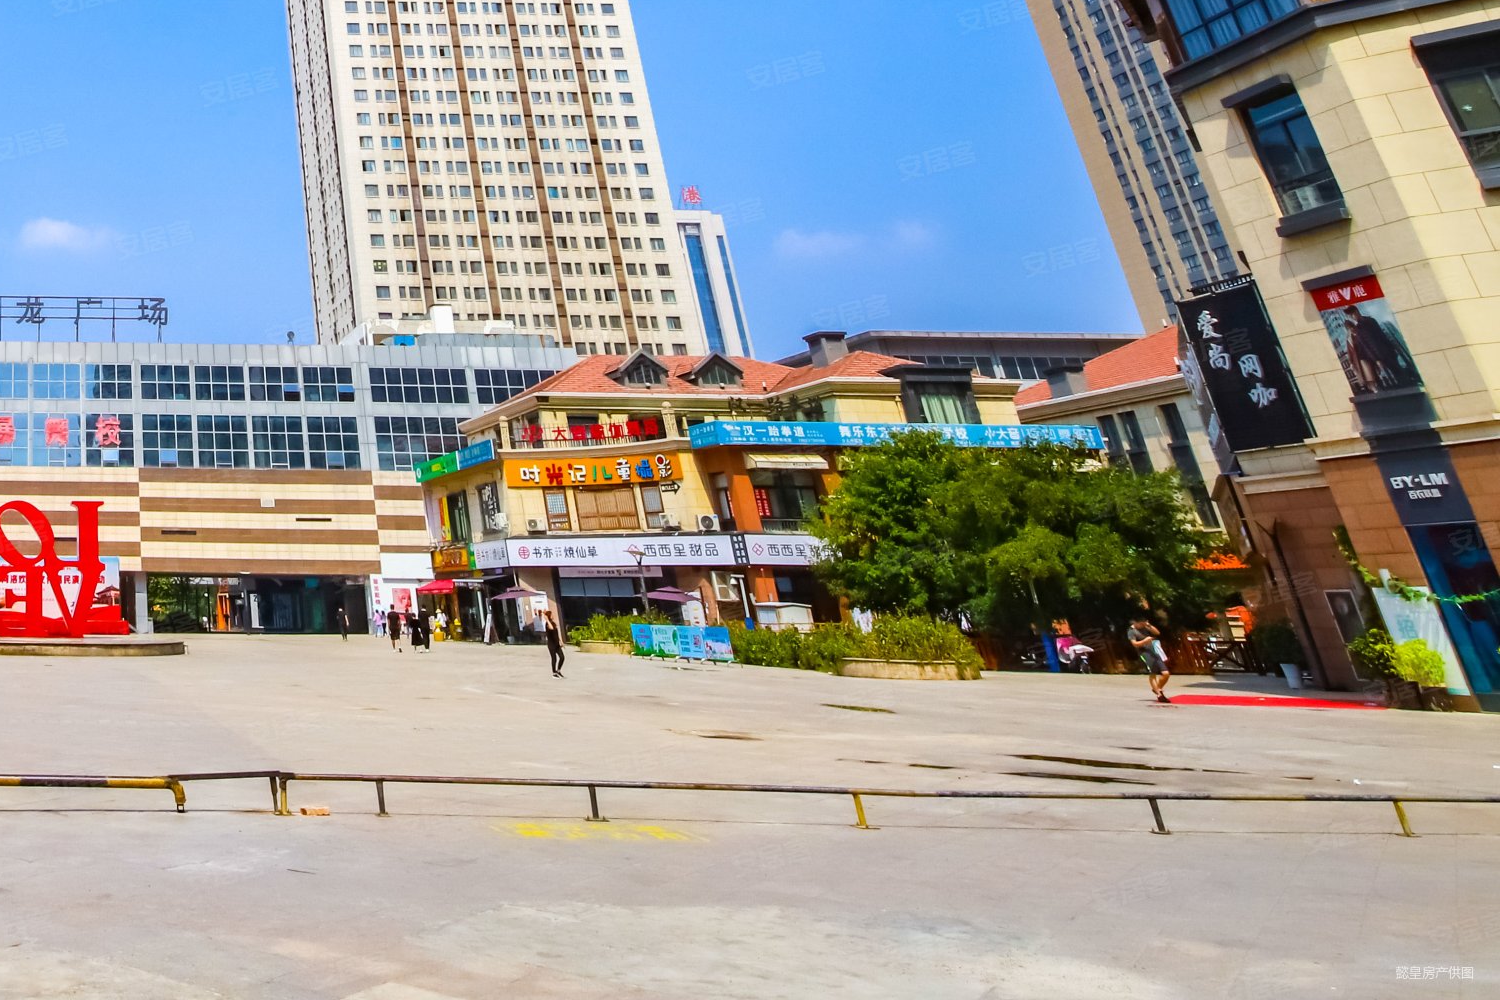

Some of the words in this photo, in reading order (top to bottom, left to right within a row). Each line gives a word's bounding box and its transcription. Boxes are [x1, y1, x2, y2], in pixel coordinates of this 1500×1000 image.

[743, 424, 805, 438] 汉一跆拳道
[519, 453, 673, 485] 时光记儿童摄影
[1390, 472, 1449, 489] BY-LM
[643, 543, 719, 558] 西西里甜品
